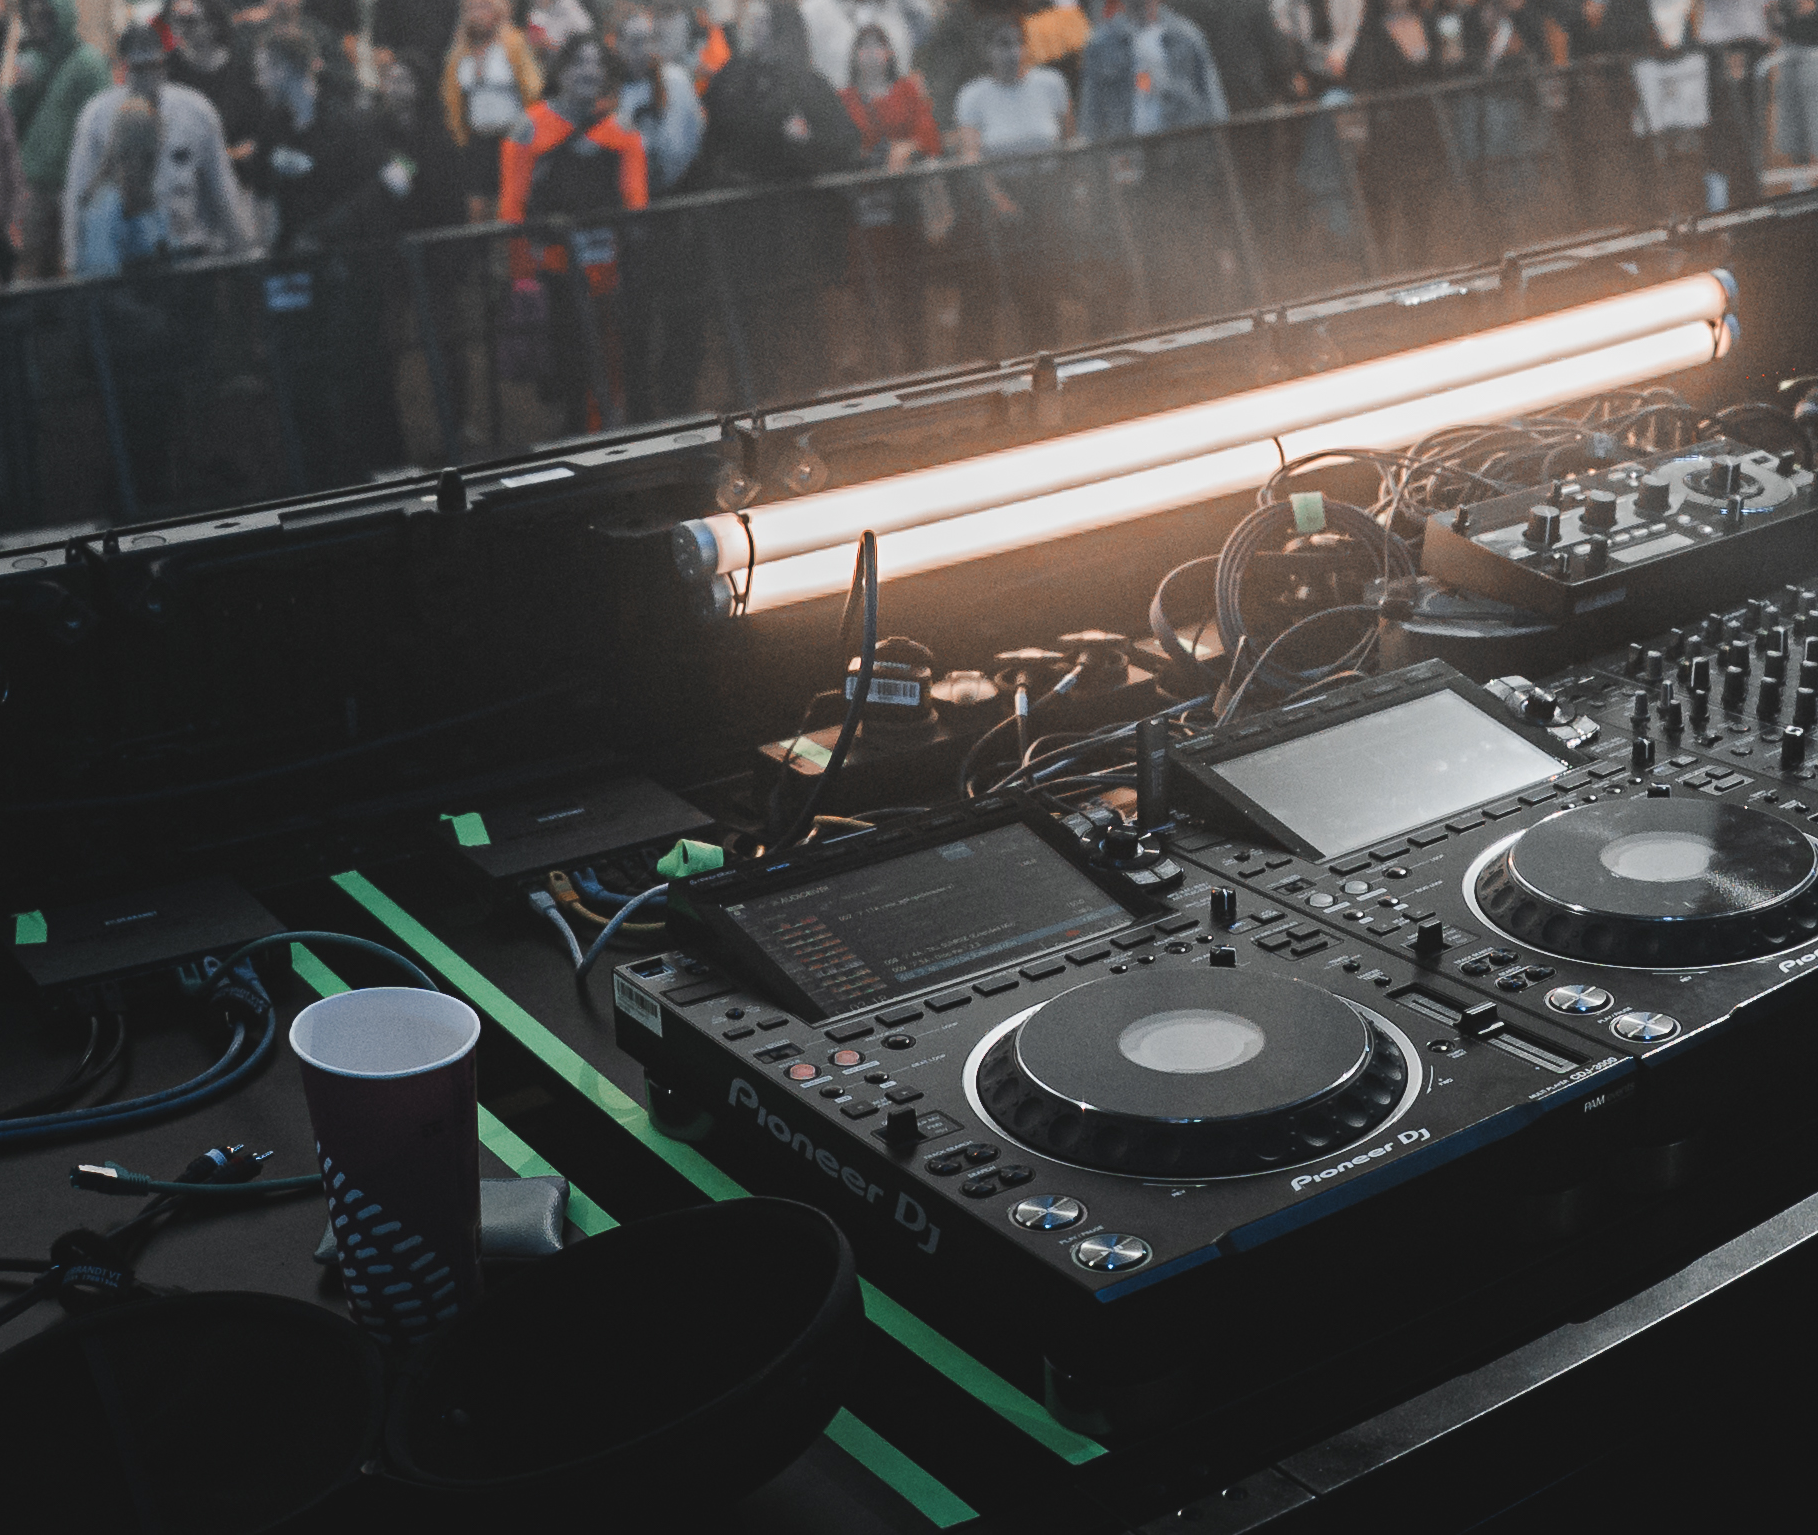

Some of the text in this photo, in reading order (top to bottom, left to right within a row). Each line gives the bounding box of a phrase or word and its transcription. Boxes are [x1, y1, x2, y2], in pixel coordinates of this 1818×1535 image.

[1569, 1056, 1619, 1081] CDJ-3000
[1584, 1094, 1606, 1113] PAM
[728, 1077, 884, 1206] Pioneer
[1290, 1141, 1395, 1193] Pioneer
